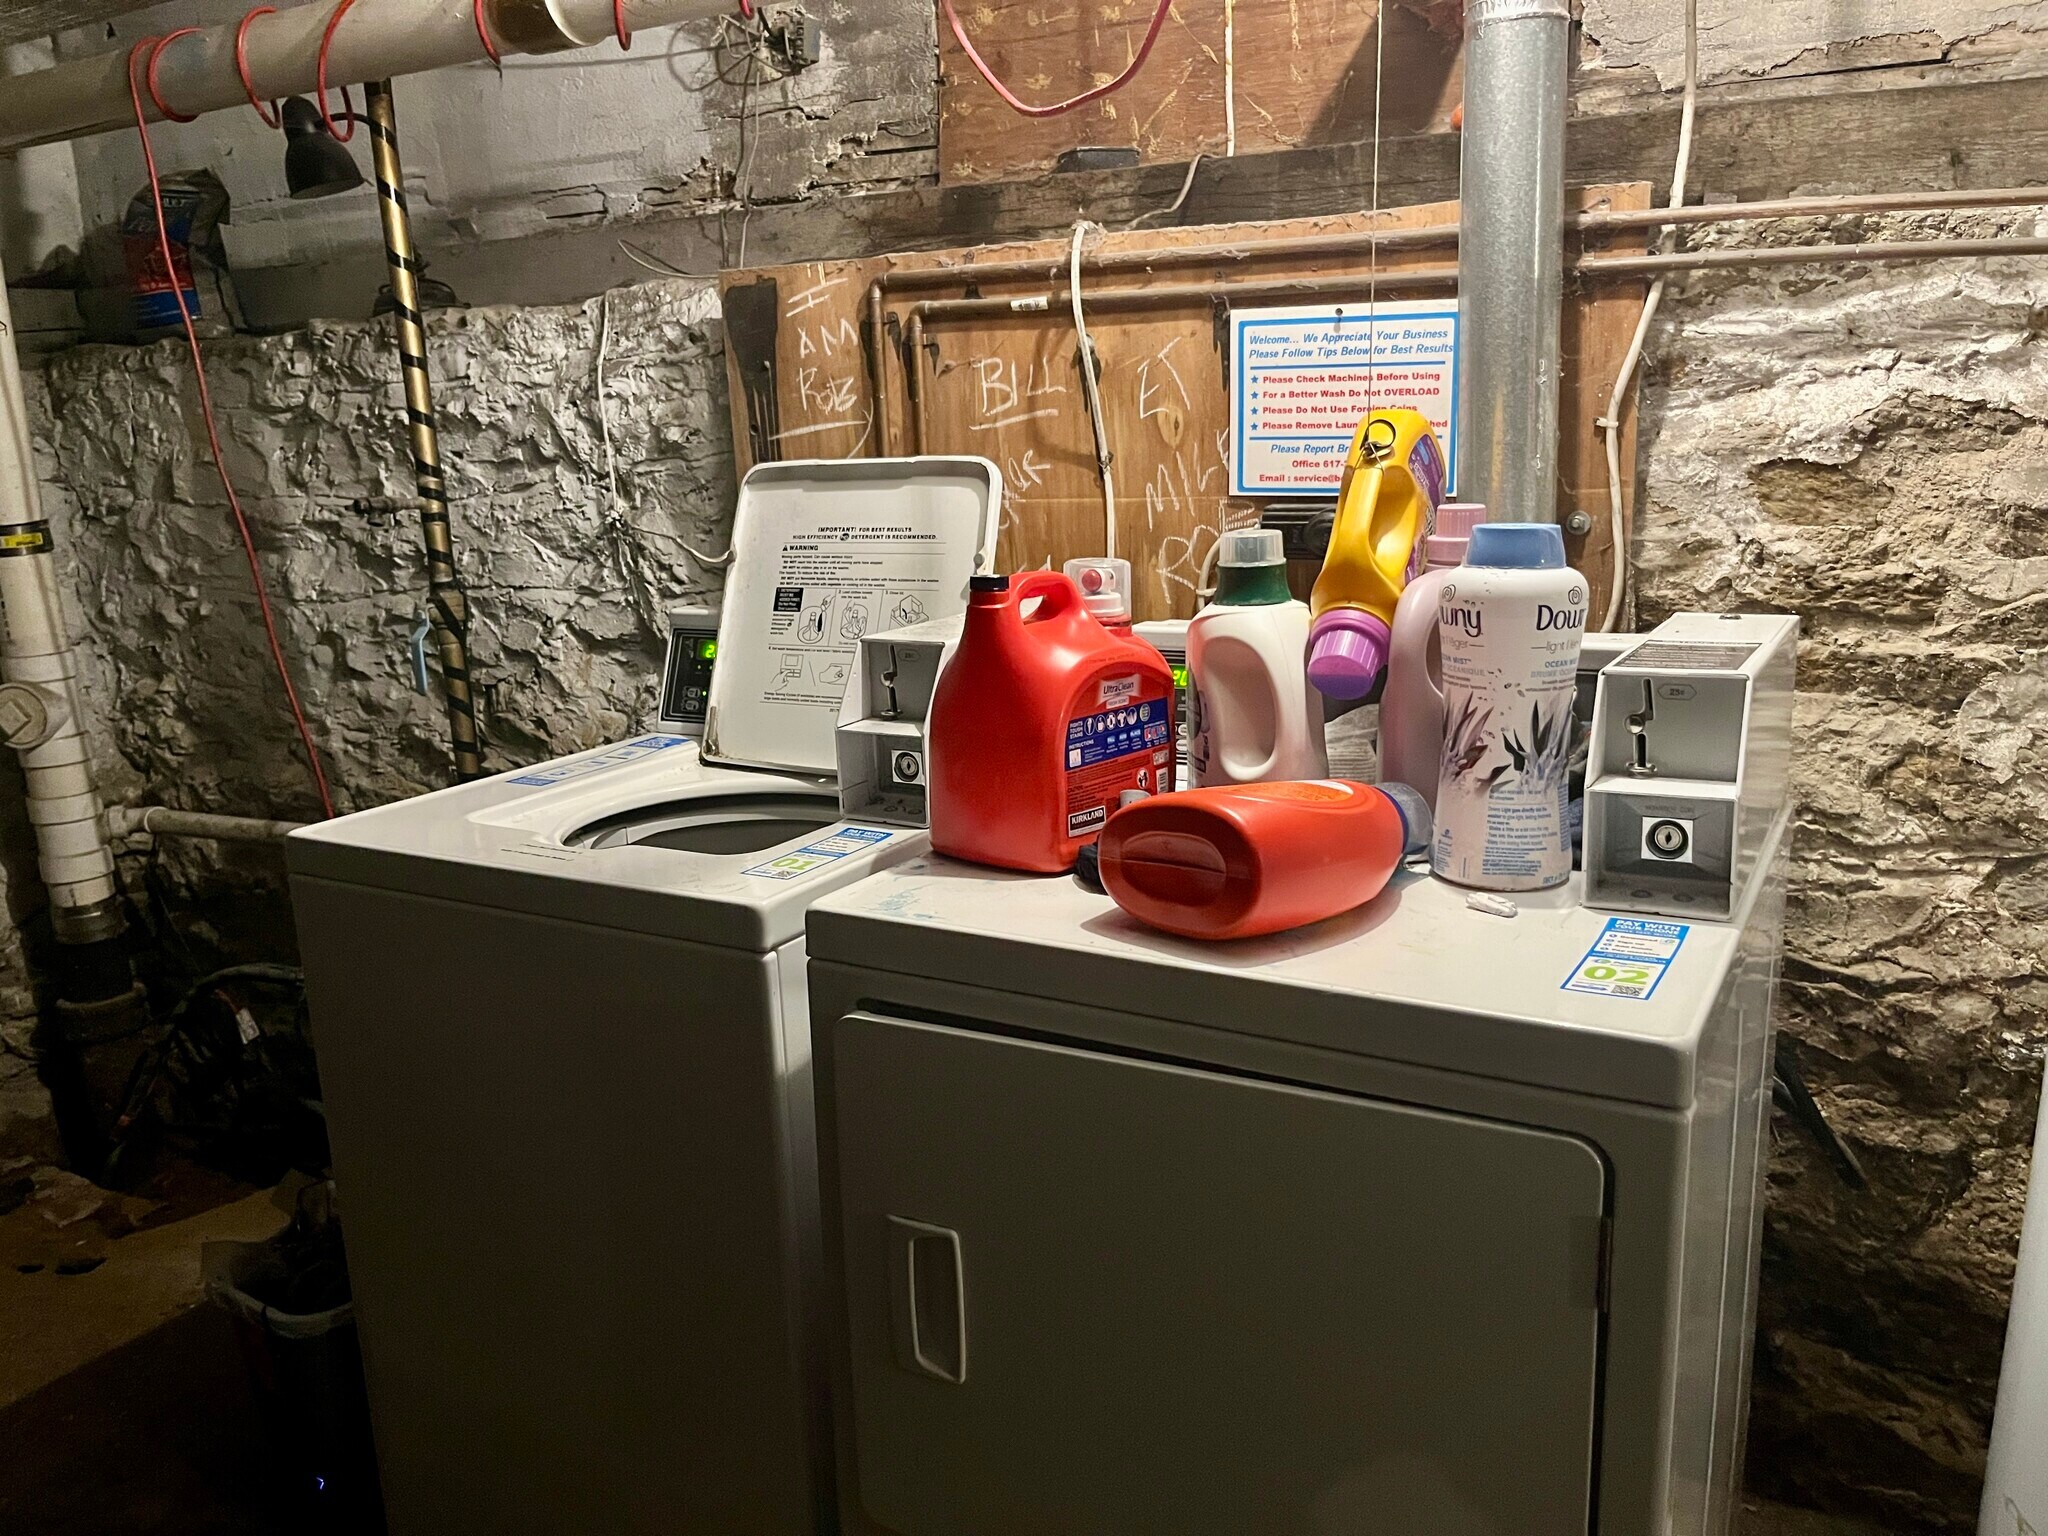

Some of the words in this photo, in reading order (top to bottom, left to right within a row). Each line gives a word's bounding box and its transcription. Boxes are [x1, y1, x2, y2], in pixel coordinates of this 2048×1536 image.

[798, 318, 859, 358] AM
[1249, 335, 1299, 344] Welcome...
[1303, 333, 1318, 342] We
[1321, 332, 1372, 344] Appreciate
[1377, 331, 1399, 340] Your
[1403, 329, 1448, 339] Business
[1249, 350, 1278, 358] Please
[1282, 348, 1313, 358] Follow
[1317, 347, 1337, 359] Tips
[1341, 346, 1370, 356] Below
[1373, 346, 1387, 354] for
[1390, 344, 1413, 354] Best
[1416, 343, 1454, 354] Results
[1262, 376, 1293, 384] Please
[1296, 374, 1325, 383] Check
[1328, 374, 1373, 382] Machines
[1376, 373, 1408, 381] Before
[1412, 372, 1440, 382] Using
[1288, 390, 1318, 398] Better
[1320, 390, 1345, 398] Wash
[1384, 388, 1440, 396] OVERLOAD
[1262, 406, 1293, 414] Please
[1296, 406, 1308, 414] Do
[1262, 422, 1292, 430] Please
[1430, 420, 1448, 428] hed
[1270, 444, 1300, 453] Please
[1303, 444, 1334, 455] Report
[1338, 444, 1349, 453] Br
[1292, 460, 1320, 468] Office
[1260, 474, 1285, 482] Email
[1072, 809, 1104, 825] KIRKLAND
[771, 858, 817, 870] 01
[1644, 922, 1681, 931] WITH
[1584, 966, 1649, 985] 02
